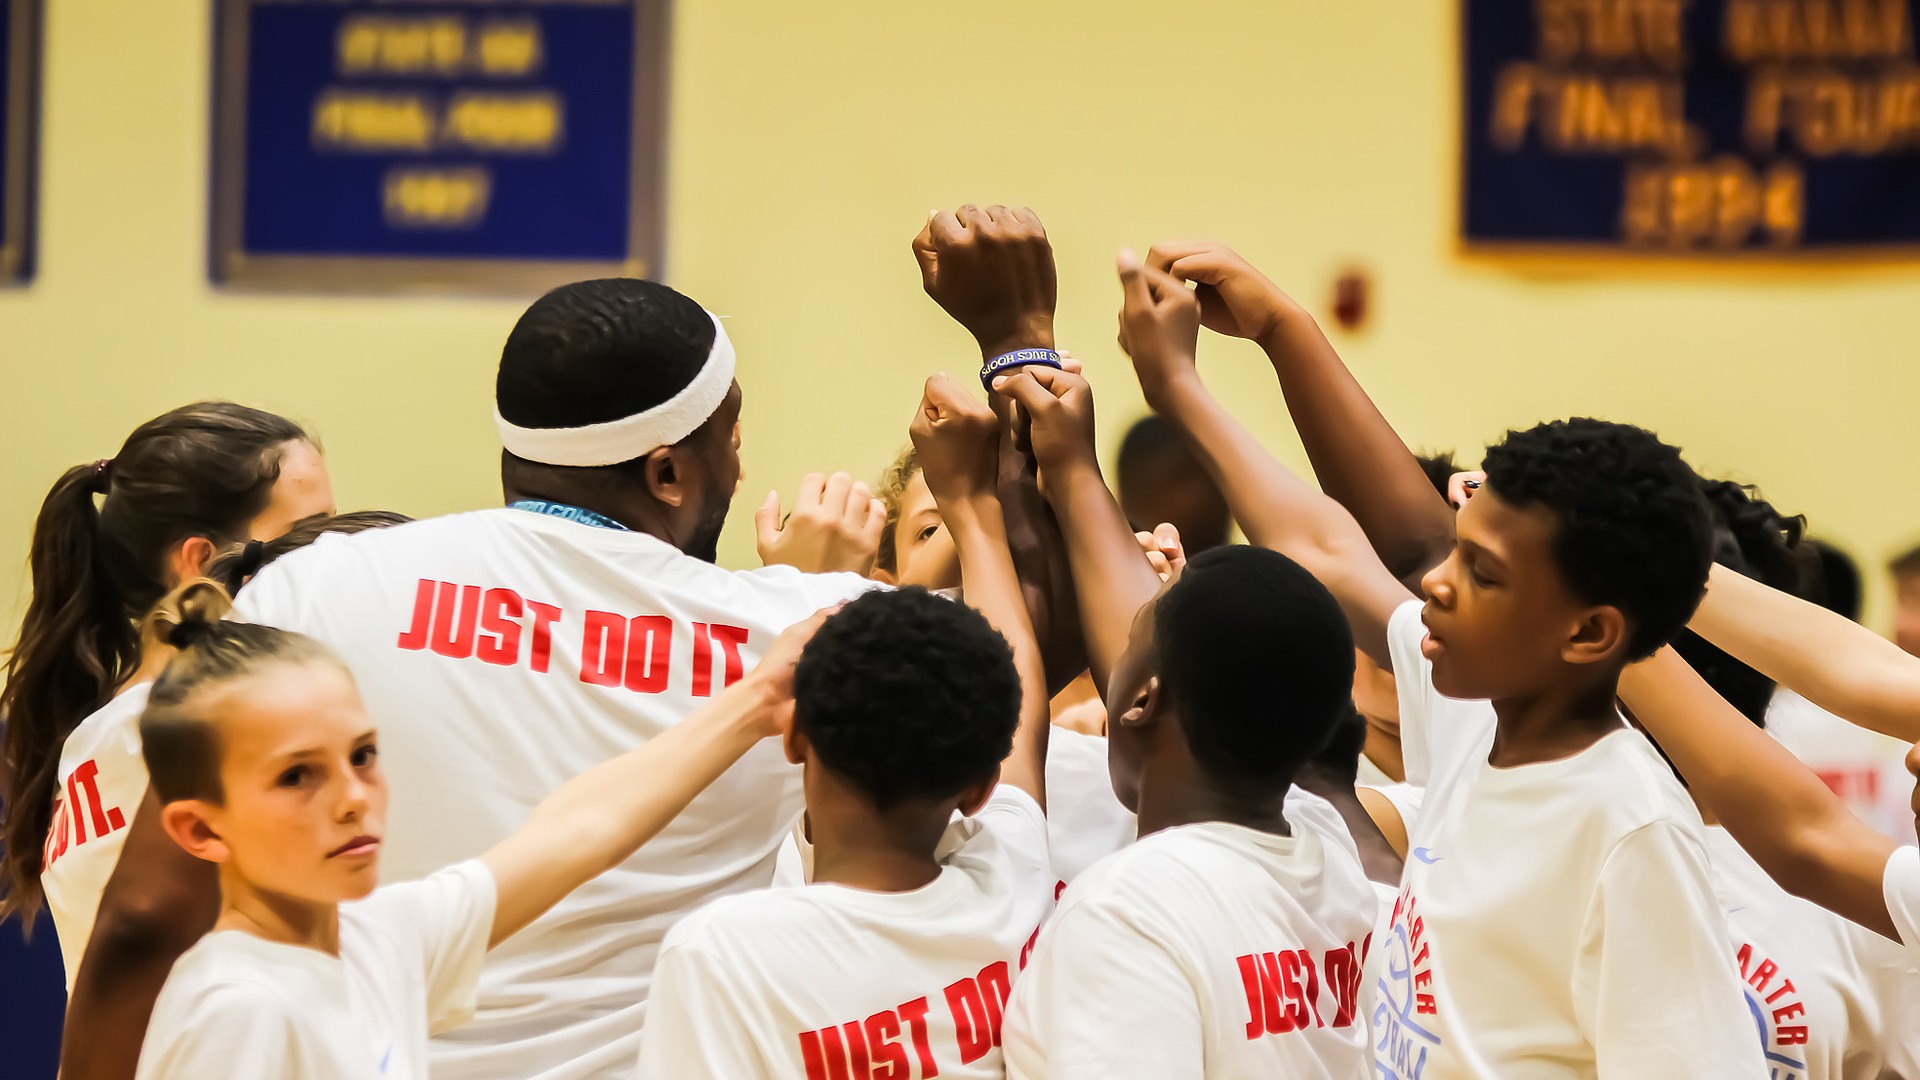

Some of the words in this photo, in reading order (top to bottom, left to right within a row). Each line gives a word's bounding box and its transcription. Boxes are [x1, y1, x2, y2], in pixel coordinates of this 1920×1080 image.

[1492, 62, 1702, 156] FINAL
[982, 354, 1015, 378] HOOPS
[1017, 351, 1047, 361] BUCS
[398, 578, 562, 673] JUST
[579, 609, 673, 694] DO
[691, 621, 749, 697] IT
[67, 759, 126, 846] IT.
[798, 996, 939, 1080] JUST
[943, 961, 1011, 1065] DO
[1236, 949, 1324, 1040] JUST
